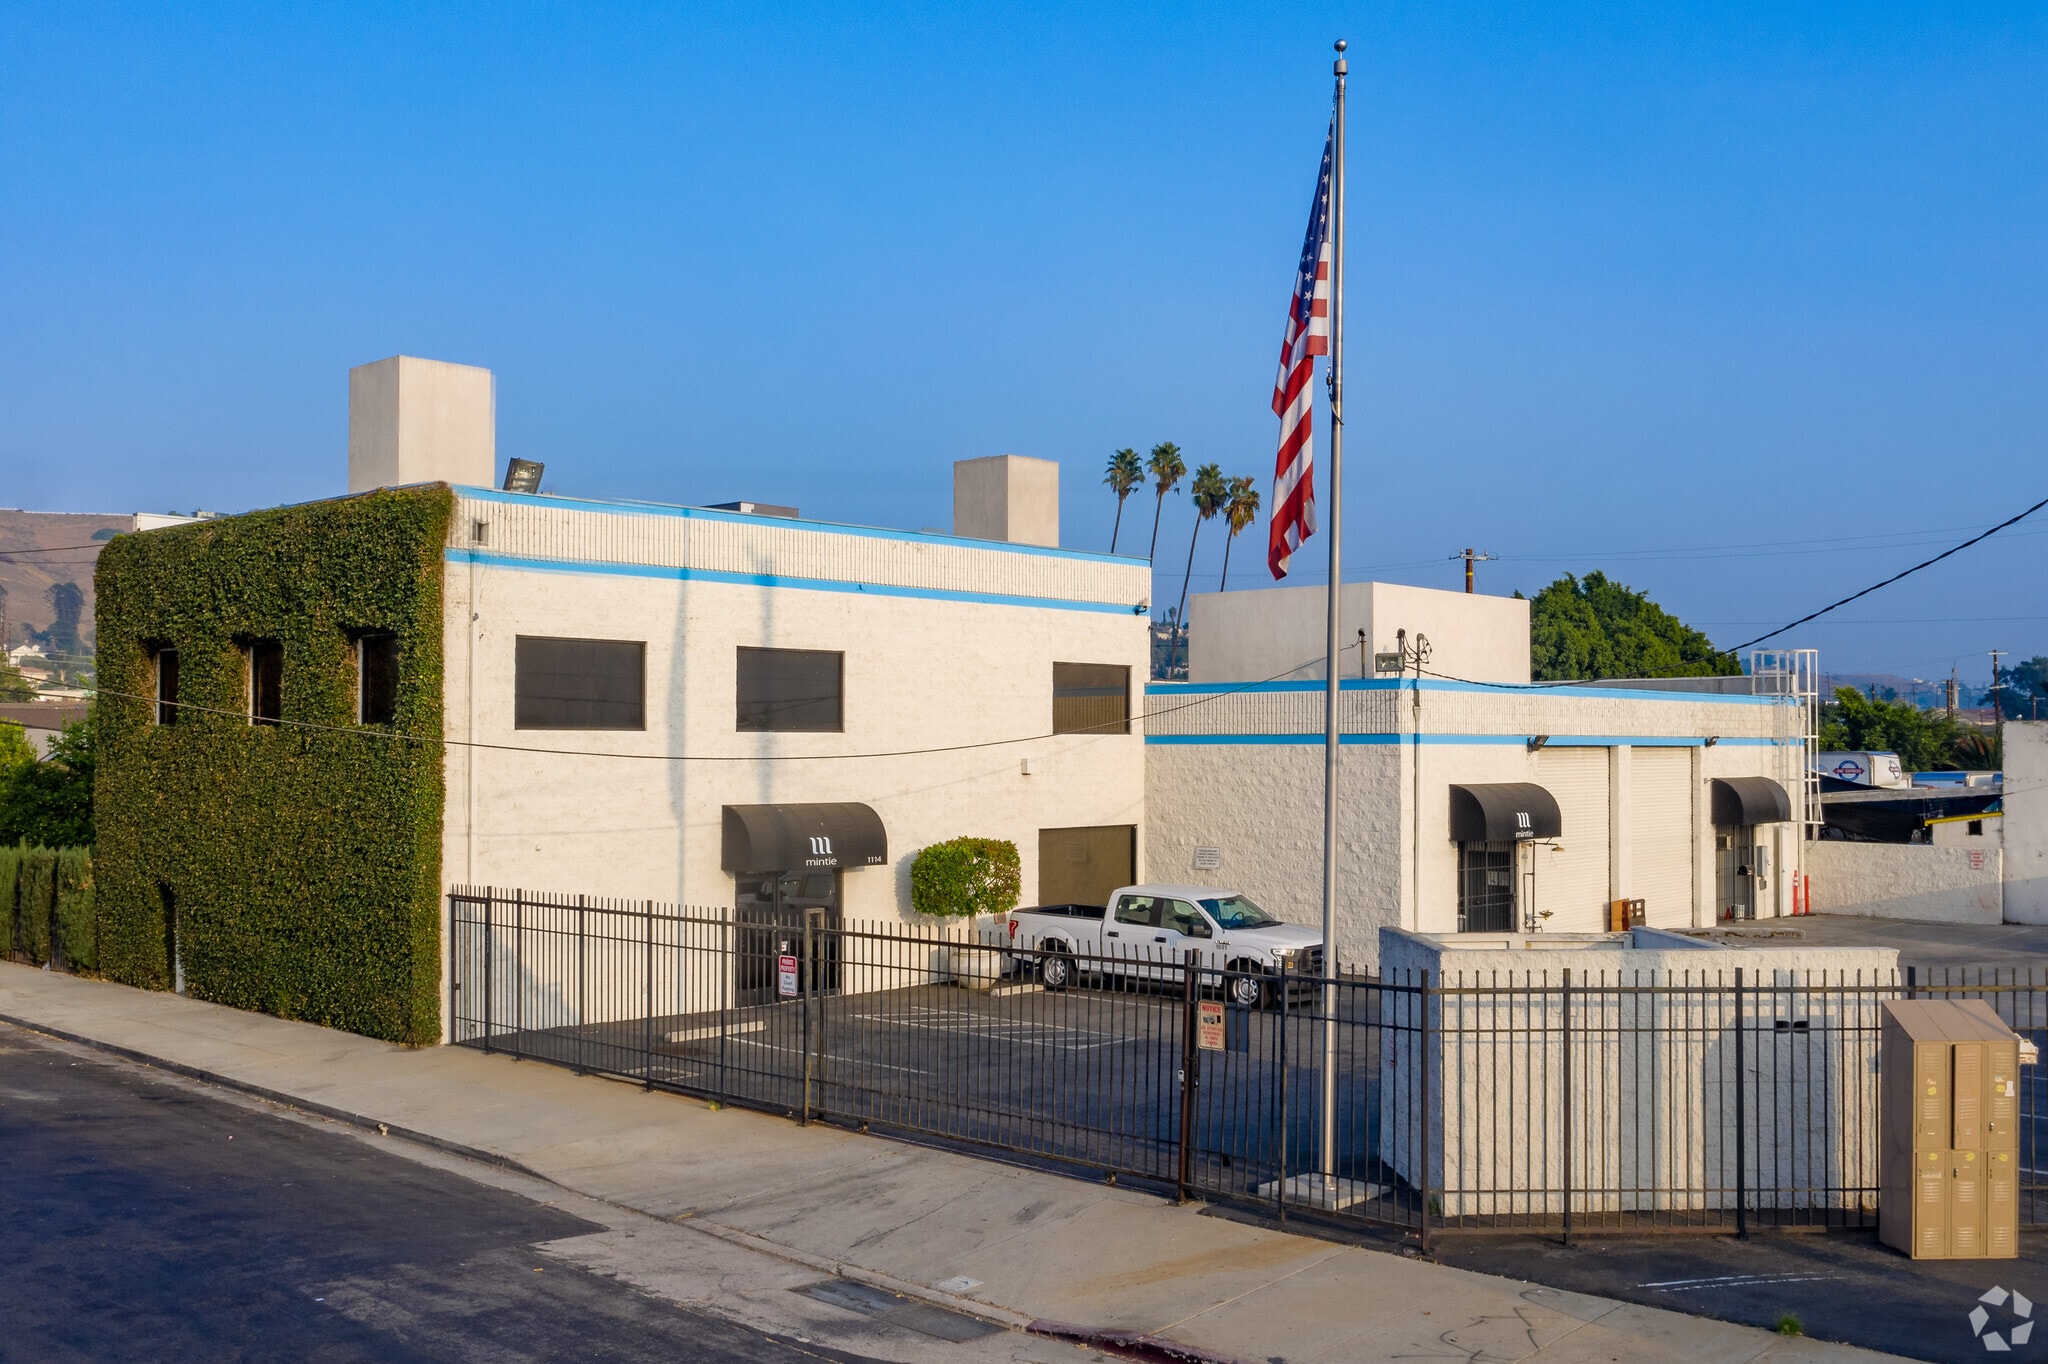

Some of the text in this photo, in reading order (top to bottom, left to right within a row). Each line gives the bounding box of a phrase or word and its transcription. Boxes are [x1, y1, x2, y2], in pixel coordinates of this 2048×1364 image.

[1515, 830, 1534, 838] mintie
[806, 857, 837, 866] mintie
[1202, 1005, 1221, 1013] NOTICE
